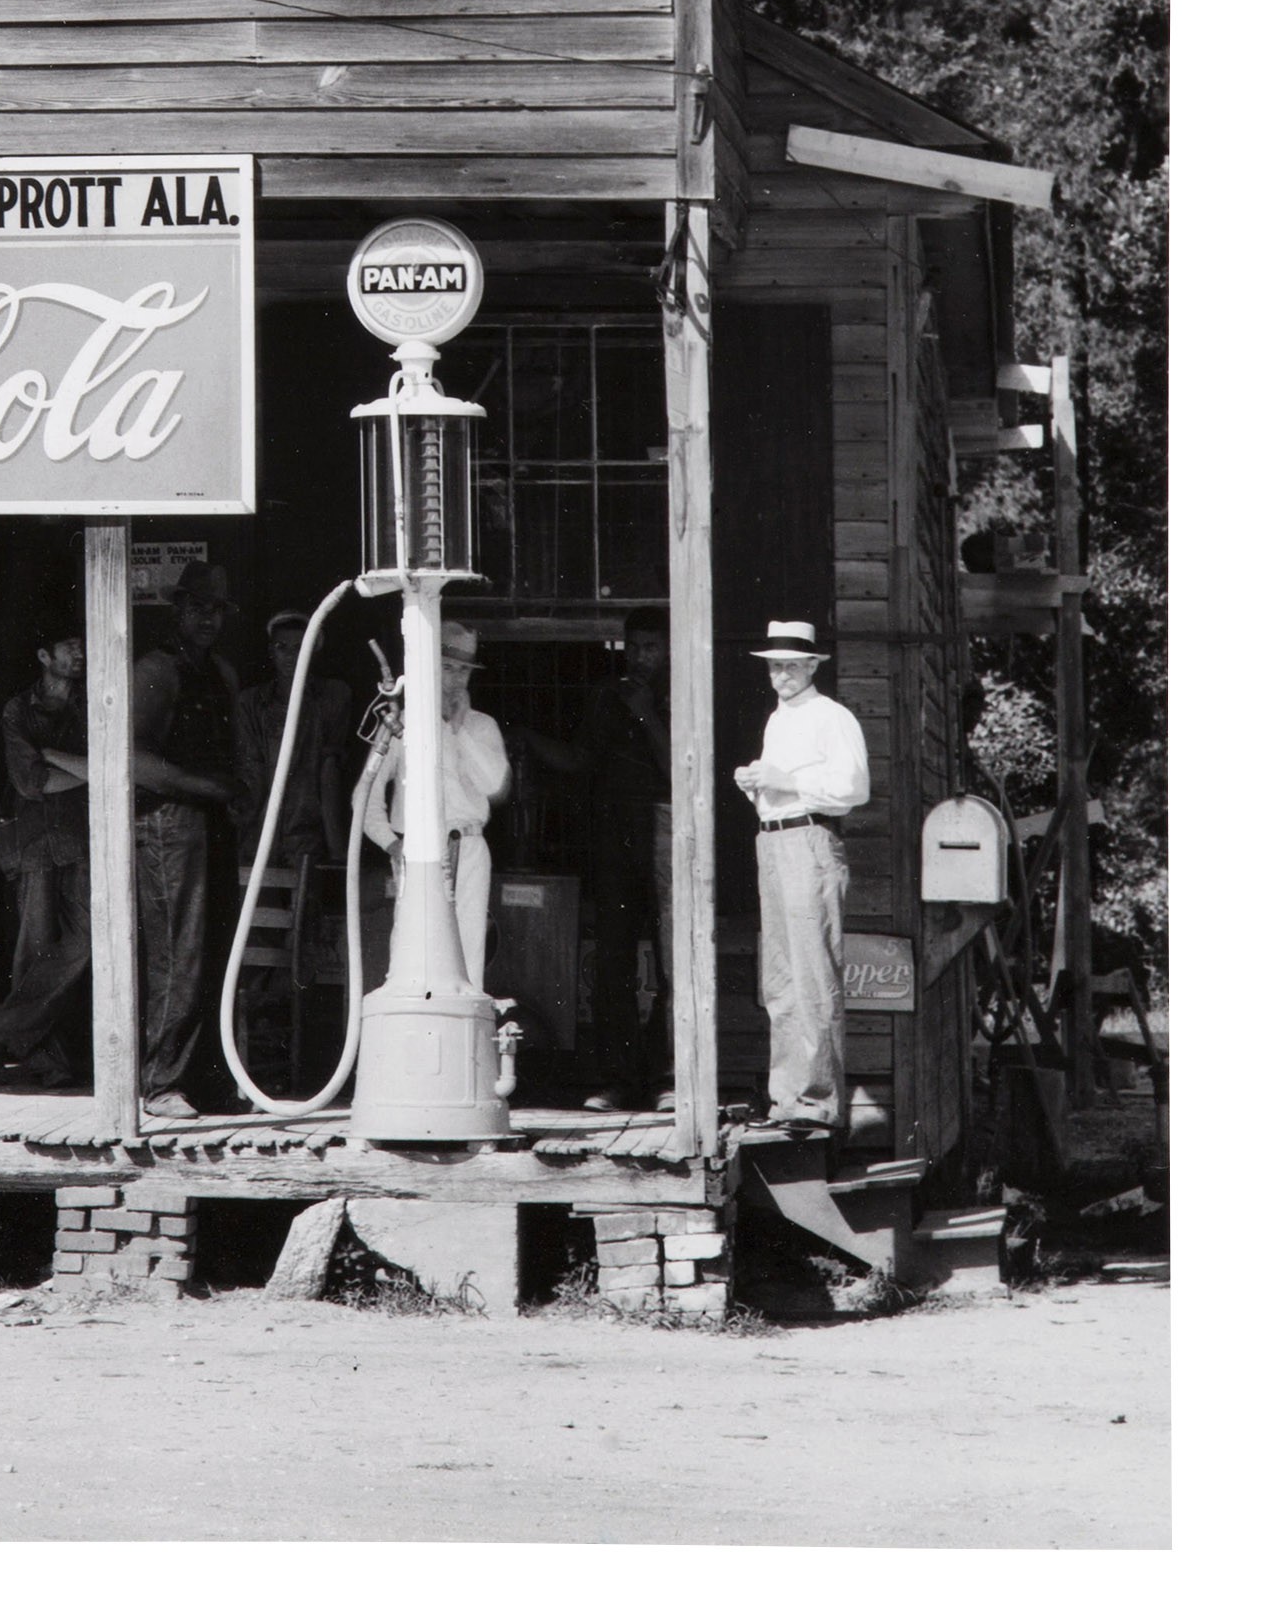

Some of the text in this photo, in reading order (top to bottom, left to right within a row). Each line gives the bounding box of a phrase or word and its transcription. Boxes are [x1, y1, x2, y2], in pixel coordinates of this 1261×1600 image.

[140, 176, 240, 227] ALA.
[363, 266, 462, 292] PAN-AM
[373, 301, 454, 329] GASOLINE
[131, 546, 203, 555] AN-AM PAN-AM
[843, 964, 910, 997] pper
